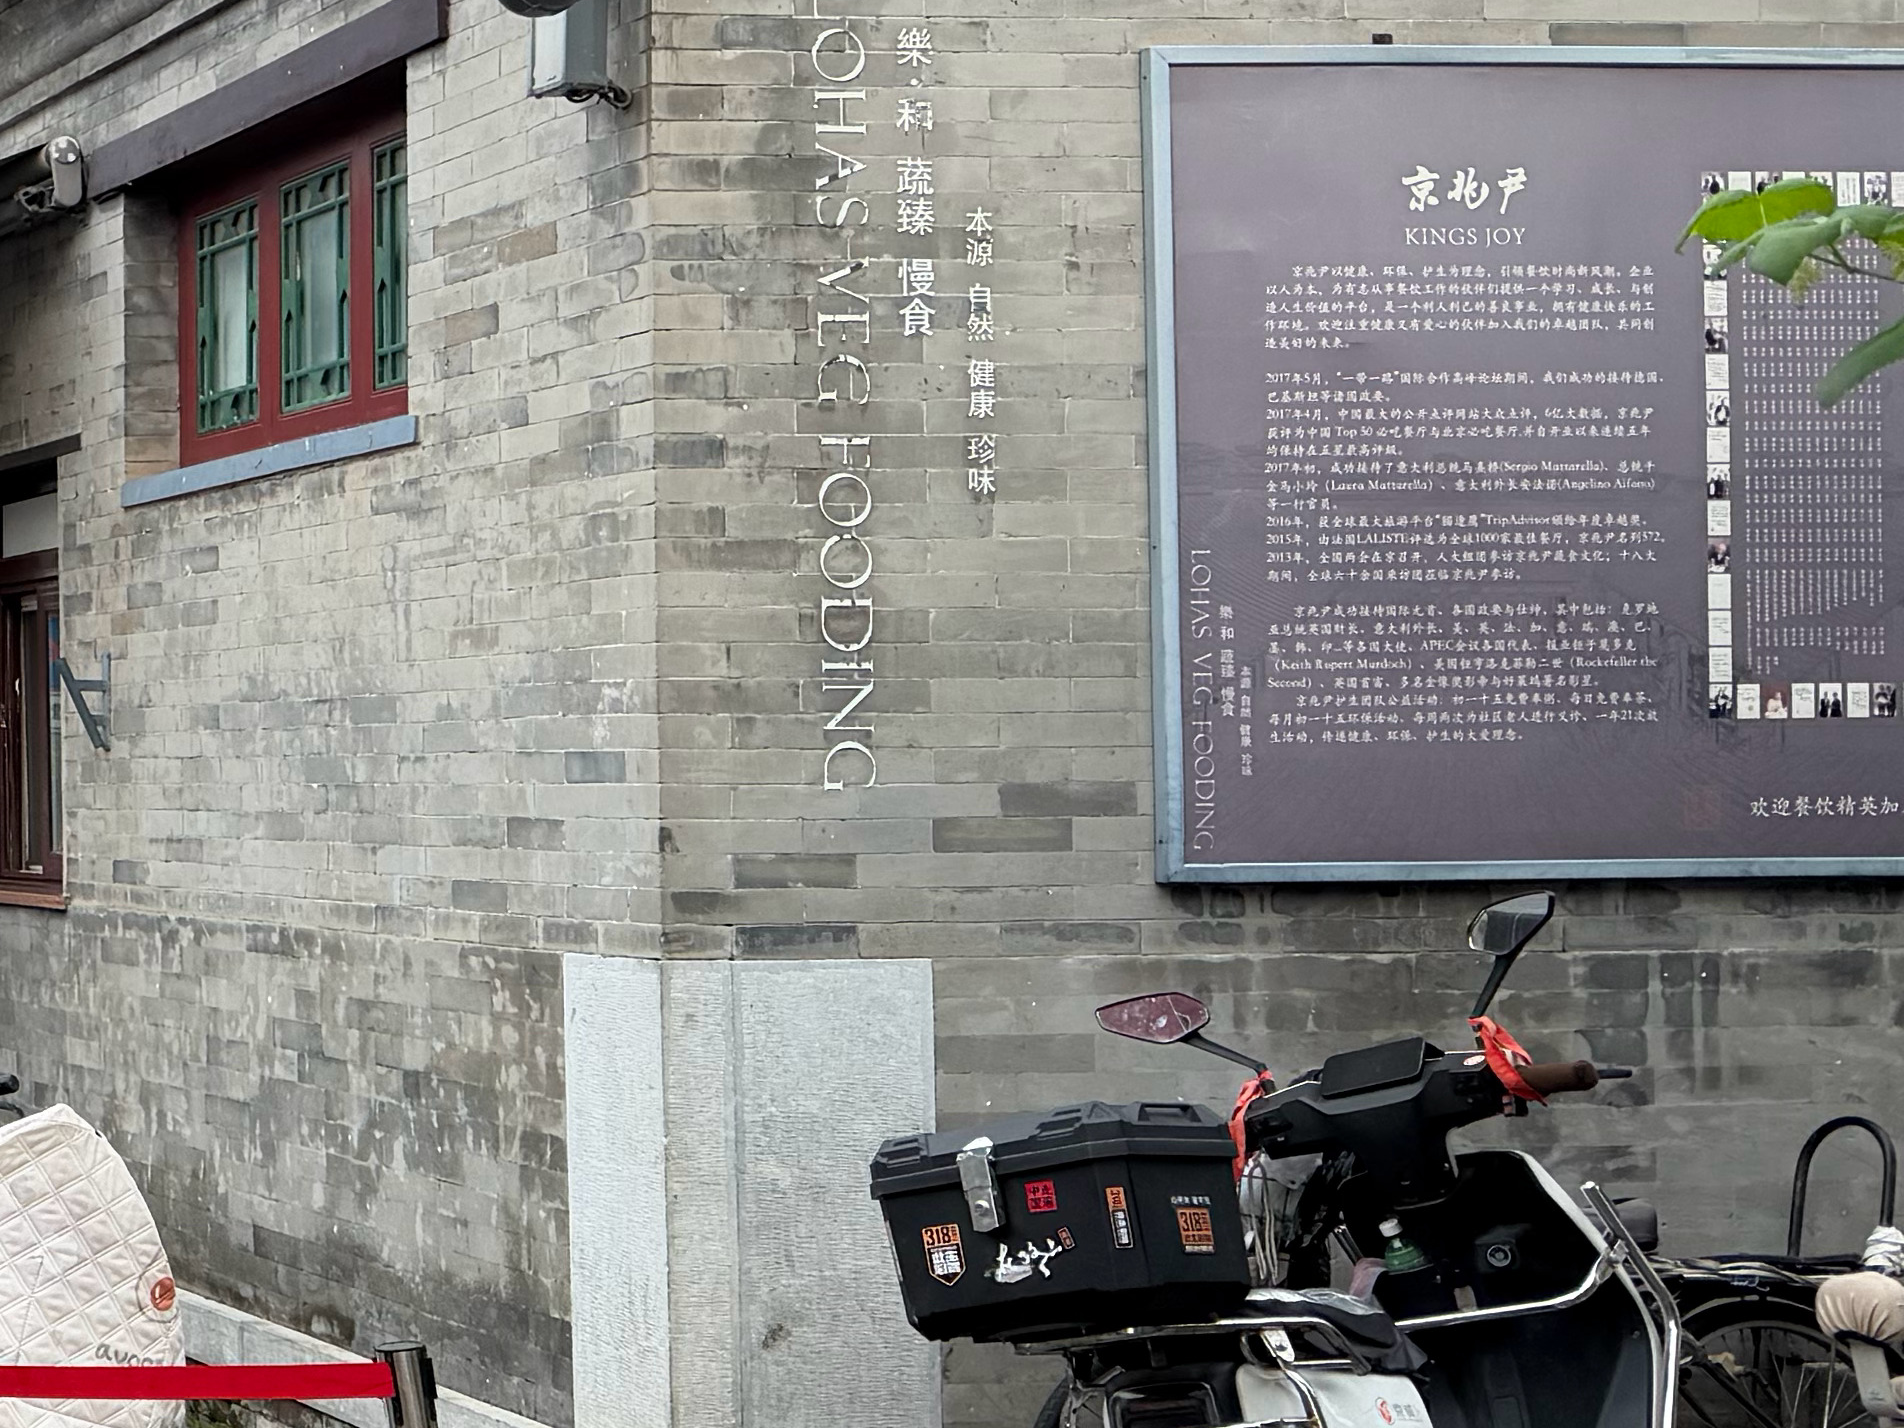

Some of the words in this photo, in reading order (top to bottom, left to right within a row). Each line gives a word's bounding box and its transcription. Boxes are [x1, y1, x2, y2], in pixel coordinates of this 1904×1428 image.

[1401, 165, 1528, 215] 京兆尹
[963, 205, 995, 269] 本源
[1405, 227, 1478, 246] KINGS
[1485, 227, 1526, 248] JOY
[896, 257, 937, 339] 慢食
[965, 282, 997, 343] 自然
[815, 262, 872, 405] VEG
[965, 357, 997, 420] 健康
[1335, 425, 1357, 439] Top
[966, 434, 998, 496] 珍味
[818, 433, 879, 793] FOODING
[1190, 549, 1212, 639] LOHAS
[1192, 652, 1213, 705] VEG
[1192, 720, 1216, 850] FOODING
[924, 1227, 952, 1246] 318
[1179, 1211, 1203, 1232] 318
